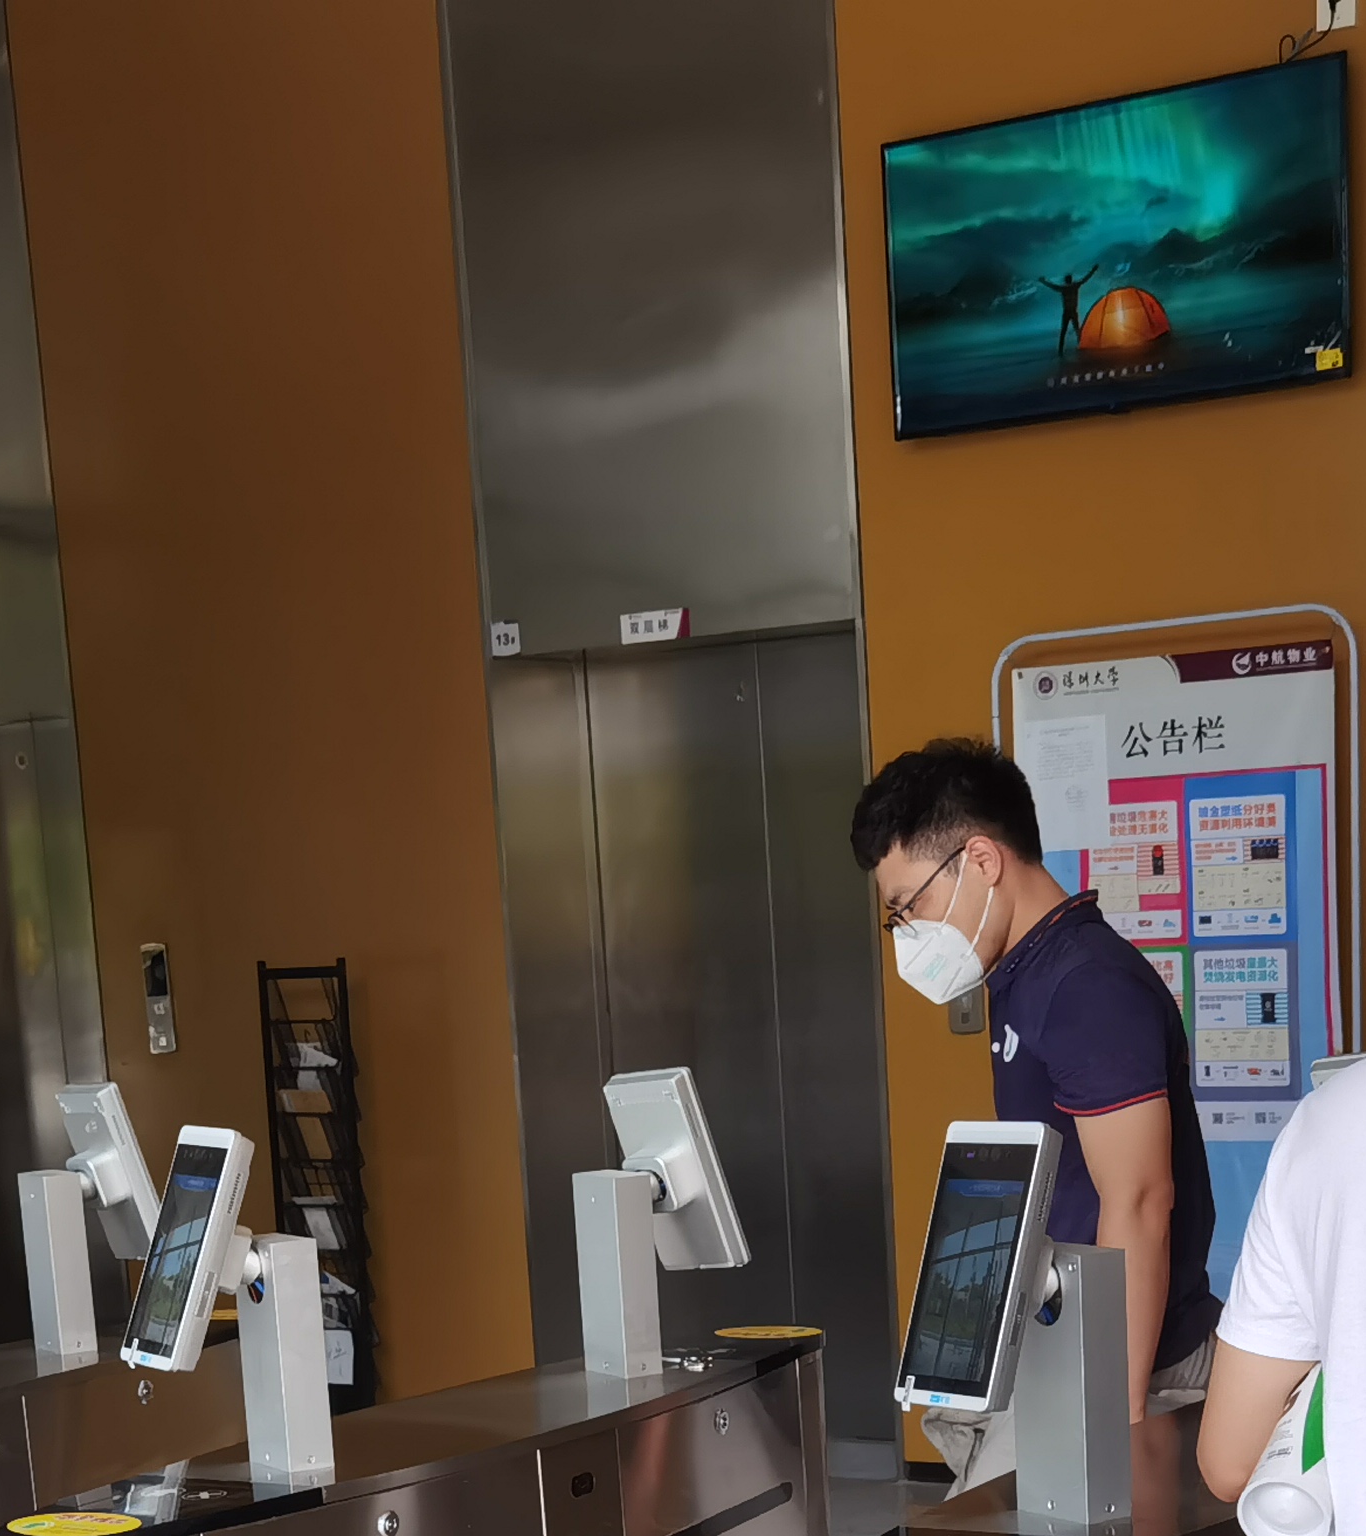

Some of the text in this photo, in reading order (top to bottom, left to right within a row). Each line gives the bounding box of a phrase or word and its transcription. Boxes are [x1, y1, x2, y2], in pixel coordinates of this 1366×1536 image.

[1255, 646, 1318, 666] 中航物业
[1062, 666, 1120, 689] 深圳大学
[1121, 715, 1226, 759] 公告栏
